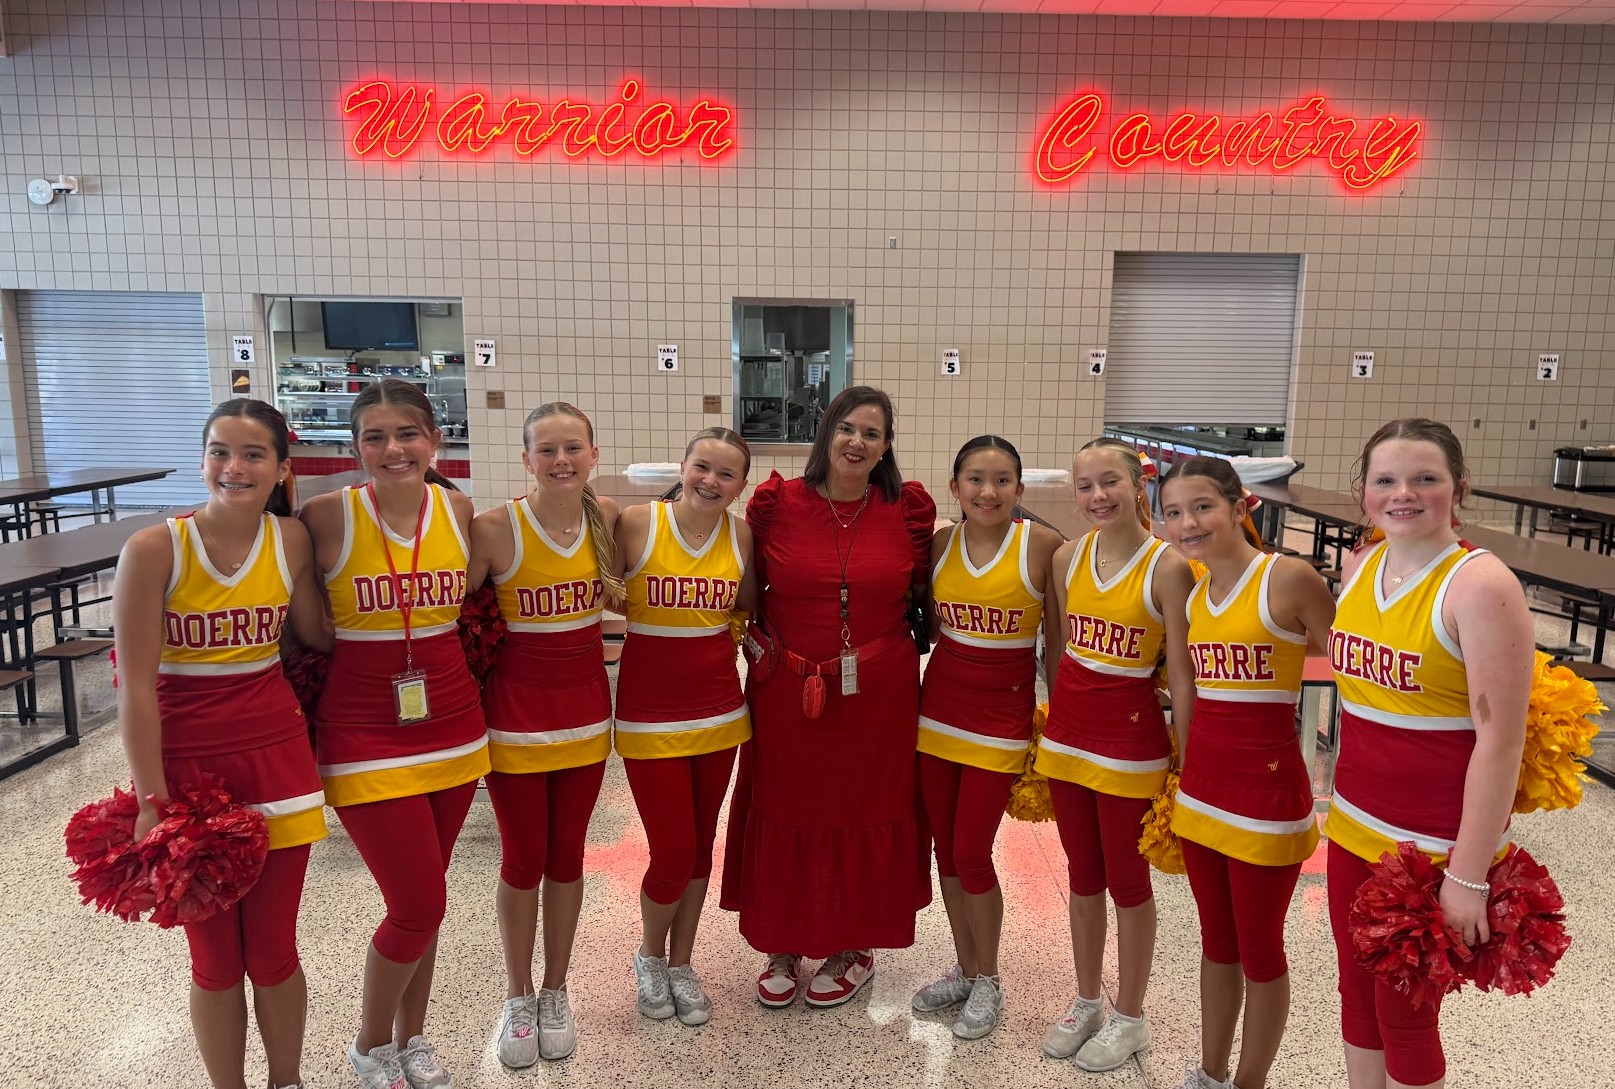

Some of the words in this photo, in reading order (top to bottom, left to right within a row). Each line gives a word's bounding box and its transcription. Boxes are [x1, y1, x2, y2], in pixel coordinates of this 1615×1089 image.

[343, 80, 733, 159] Warrior
[1036, 93, 1421, 189] Country
[515, 578, 606, 619] DOERR
[646, 575, 739, 611] DOERRE
